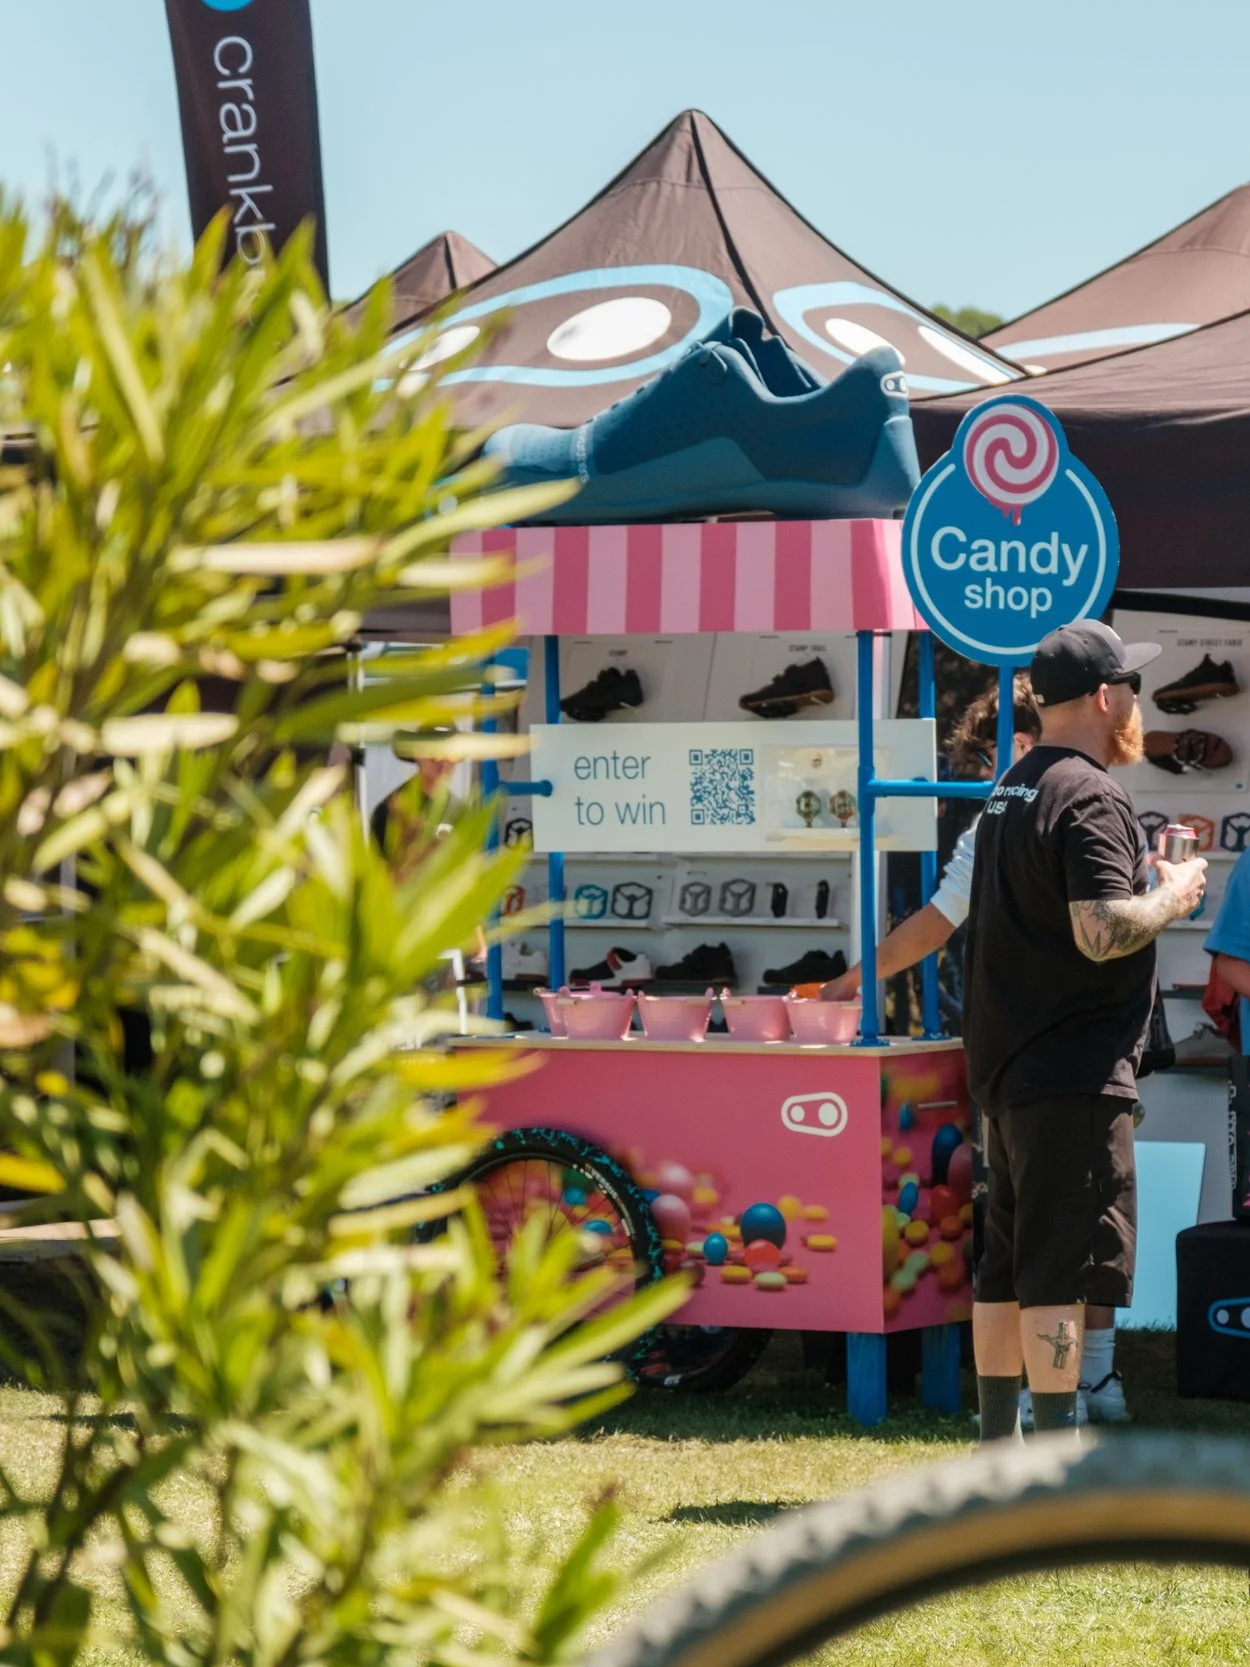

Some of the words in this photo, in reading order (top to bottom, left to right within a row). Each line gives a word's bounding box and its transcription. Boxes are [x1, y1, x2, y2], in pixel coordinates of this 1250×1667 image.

[931, 526, 1089, 587] Candy
[964, 578, 1053, 619] shop
[574, 751, 651, 780] enter
[576, 799, 605, 826] to
[615, 794, 666, 826] win
